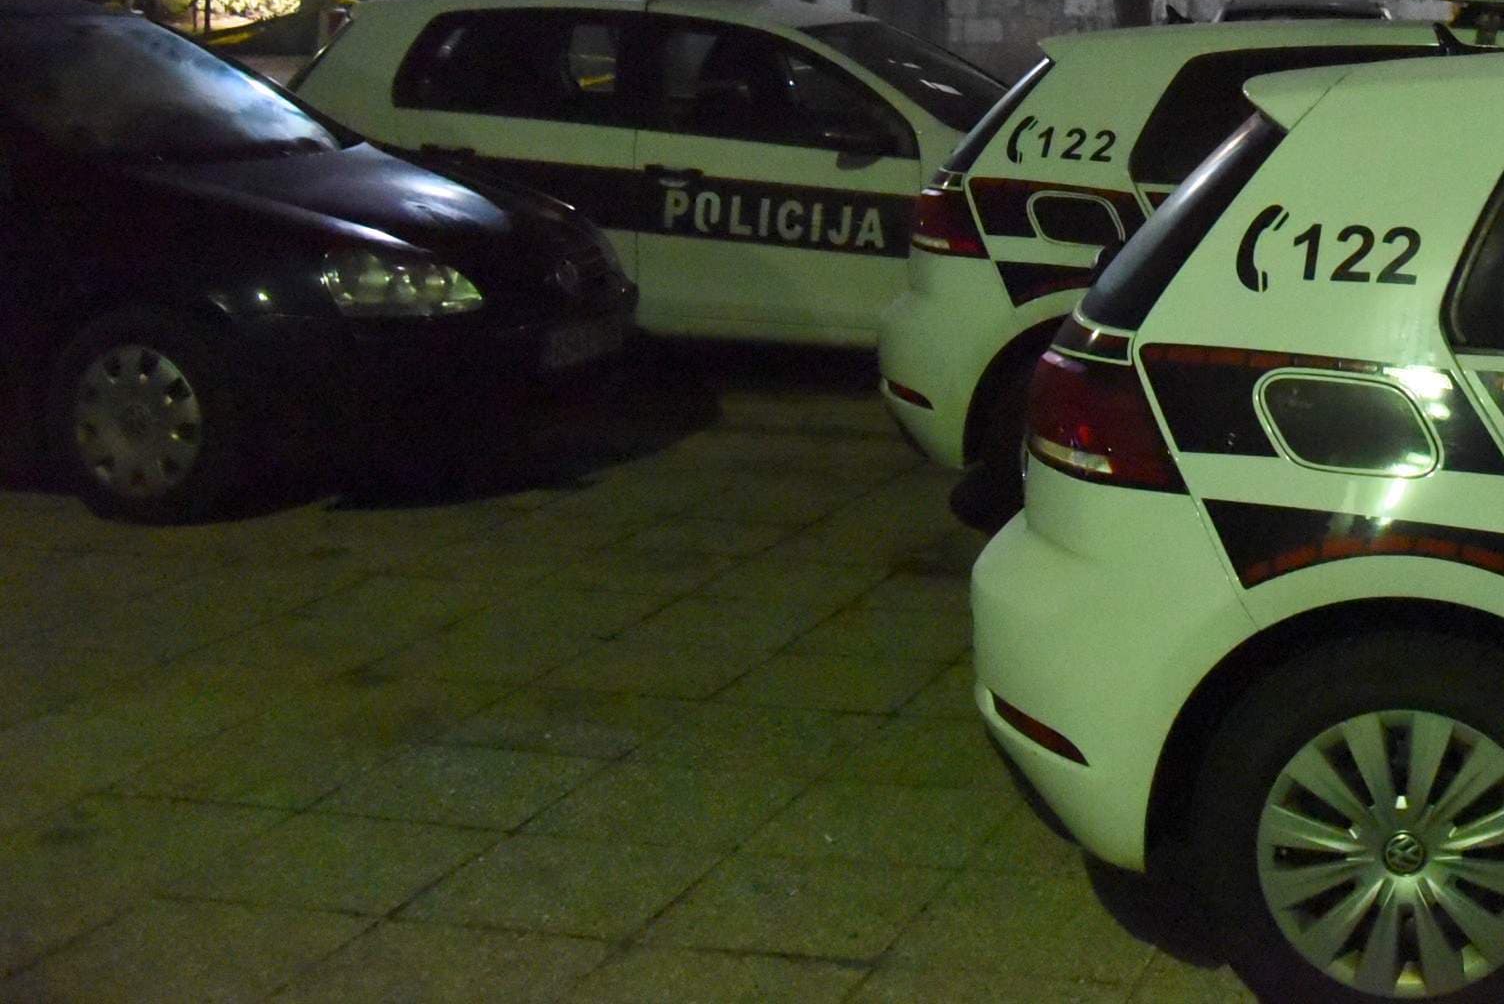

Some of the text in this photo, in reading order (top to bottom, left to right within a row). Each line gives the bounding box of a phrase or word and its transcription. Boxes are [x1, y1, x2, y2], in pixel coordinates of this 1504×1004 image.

[1038, 126, 1116, 162] 122
[661, 188, 885, 248] POLICIJA
[1293, 213, 1421, 285] 122
